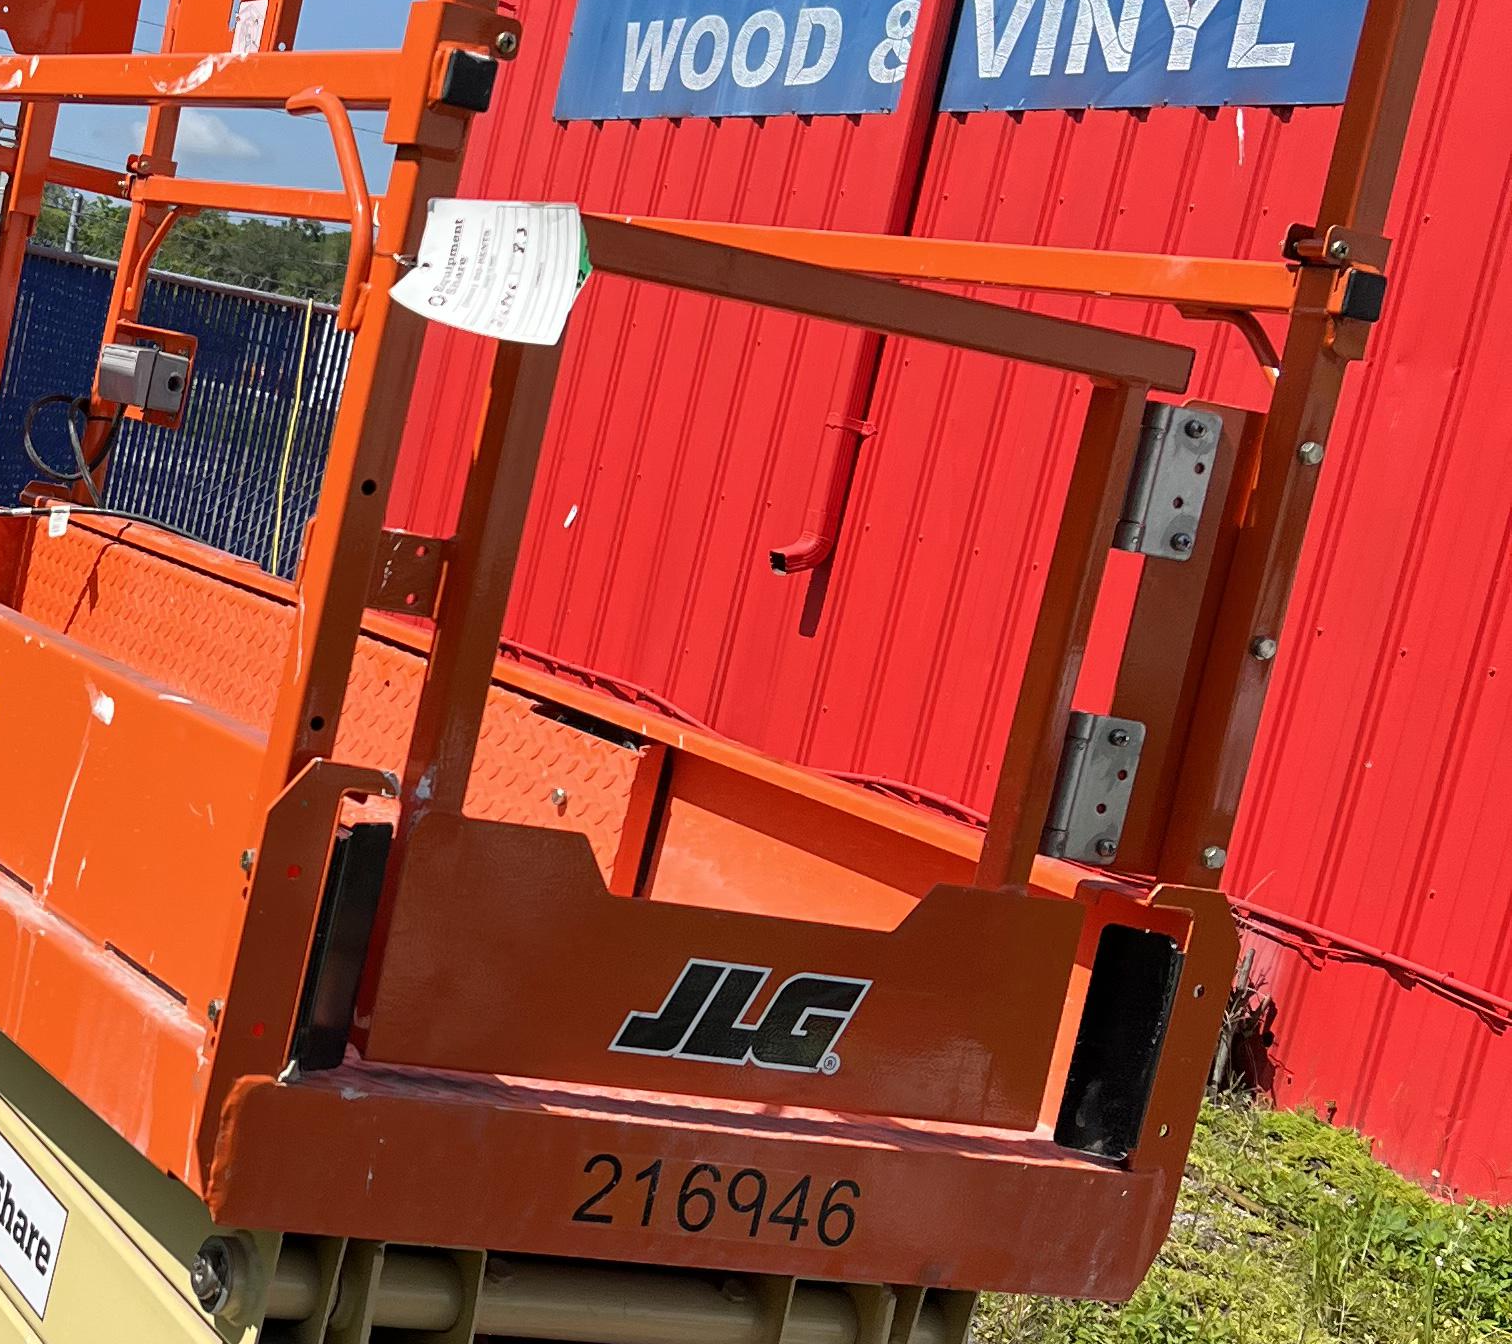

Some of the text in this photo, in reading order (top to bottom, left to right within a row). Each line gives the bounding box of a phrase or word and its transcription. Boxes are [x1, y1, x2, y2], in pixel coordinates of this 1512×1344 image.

[621, 6, 843, 93] WOOD
[432, 217, 465, 294] Equipment
[446, 254, 469, 307] Share
[608, 958, 874, 1073] JLG
[571, 1153, 861, 1247] 216946
